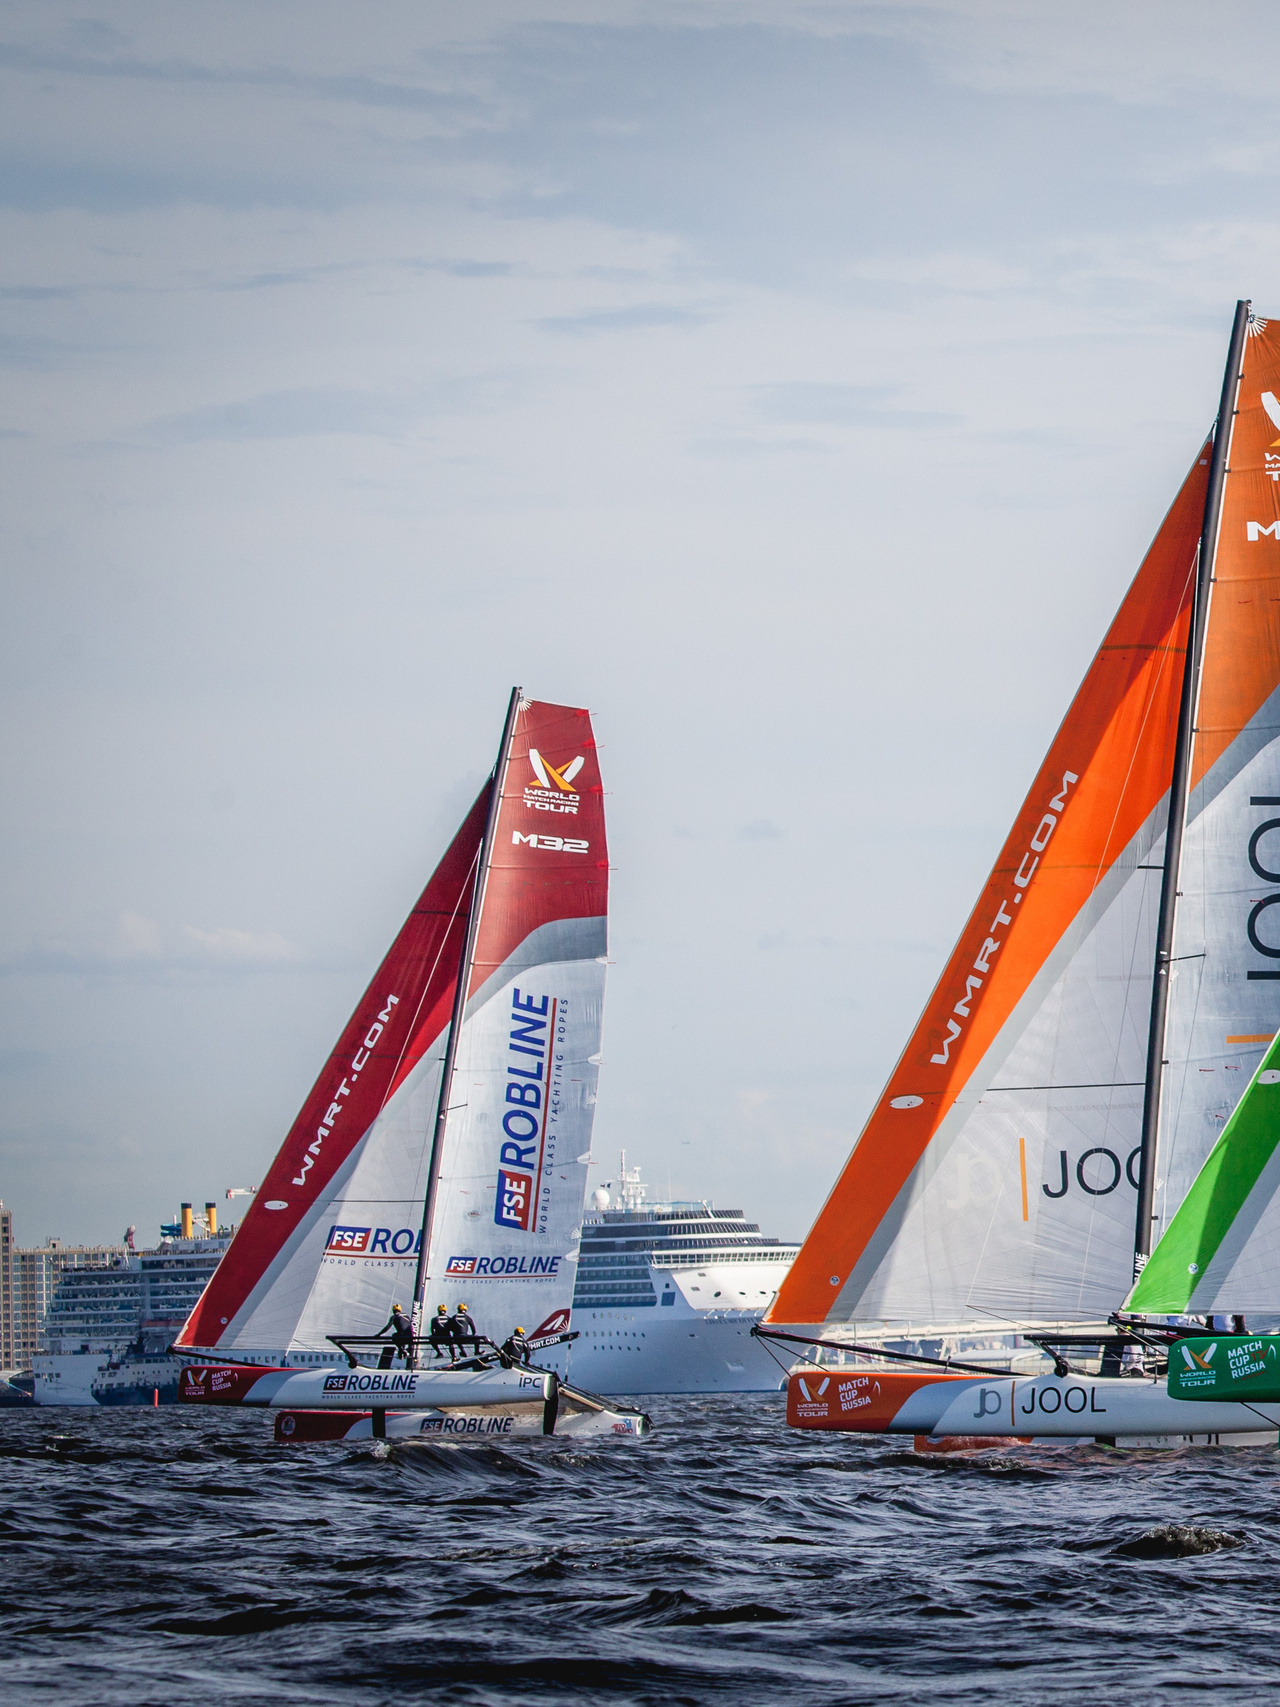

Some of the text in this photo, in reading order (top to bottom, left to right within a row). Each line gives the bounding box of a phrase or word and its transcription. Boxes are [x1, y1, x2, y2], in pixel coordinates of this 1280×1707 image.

[523, 795, 579, 806] MATCH RACING
[524, 787, 580, 801] WORLD
[523, 799, 578, 815] TOUR
[512, 830, 589, 854] M32
[930, 770, 1079, 1065] WMRT.COM
[291, 994, 399, 1186] WMRT.COM
[500, 987, 549, 1222] FSE ROBLINE
[539, 999, 569, 1234] WORLD CLASS YACHTING ROPES
[331, 1228, 422, 1254] FSE RO
[321, 1257, 356, 1266] WORLD
[363, 1260, 395, 1268] CLASS
[450, 1256, 562, 1274] FSE ROBLINE
[528, 1336, 561, 1350] MRT.COM
[1227, 1340, 1263, 1359] MATCH
[1229, 1354, 1250, 1370] CUP
[1231, 1360, 1266, 1379] RUSSIA
[211, 1369, 232, 1379] MATCH
[326, 1374, 419, 1391] FSE ROBLINE
[1180, 1370, 1216, 1378] WORLD
[212, 1382, 232, 1391] RUSSIA
[838, 1376, 869, 1393] MATCH
[1180, 1379, 1216, 1387] TOUR
[839, 1389, 858, 1402] CUP
[841, 1395, 872, 1412] RUSSIA
[1021, 1386, 1107, 1414] JOOL
[423, 1417, 514, 1433] FSE ROBLINE
